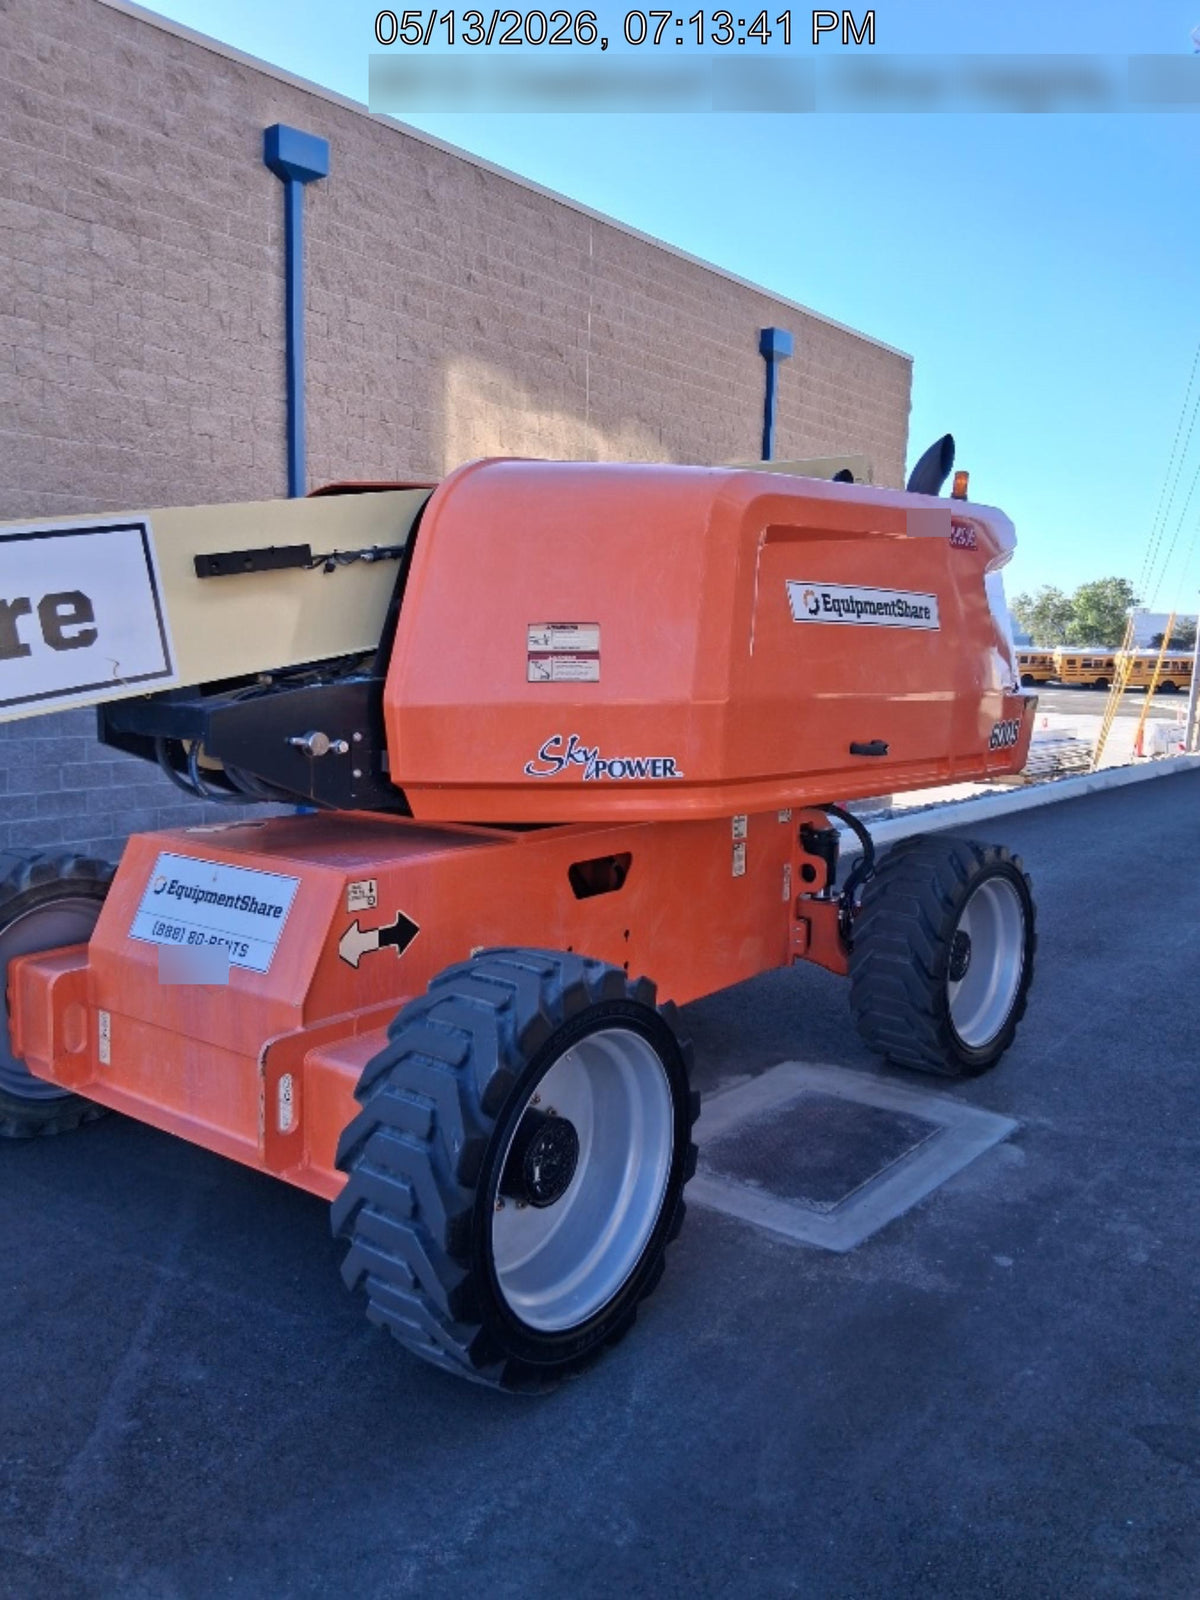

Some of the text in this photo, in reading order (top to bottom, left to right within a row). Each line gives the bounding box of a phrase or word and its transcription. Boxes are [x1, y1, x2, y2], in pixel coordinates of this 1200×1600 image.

[821, 593, 931, 620] EquipmentShare
[595, 757, 677, 779] POWER
[166, 879, 283, 919] EquipmentShare
[152, 920, 186, 942] (888)
